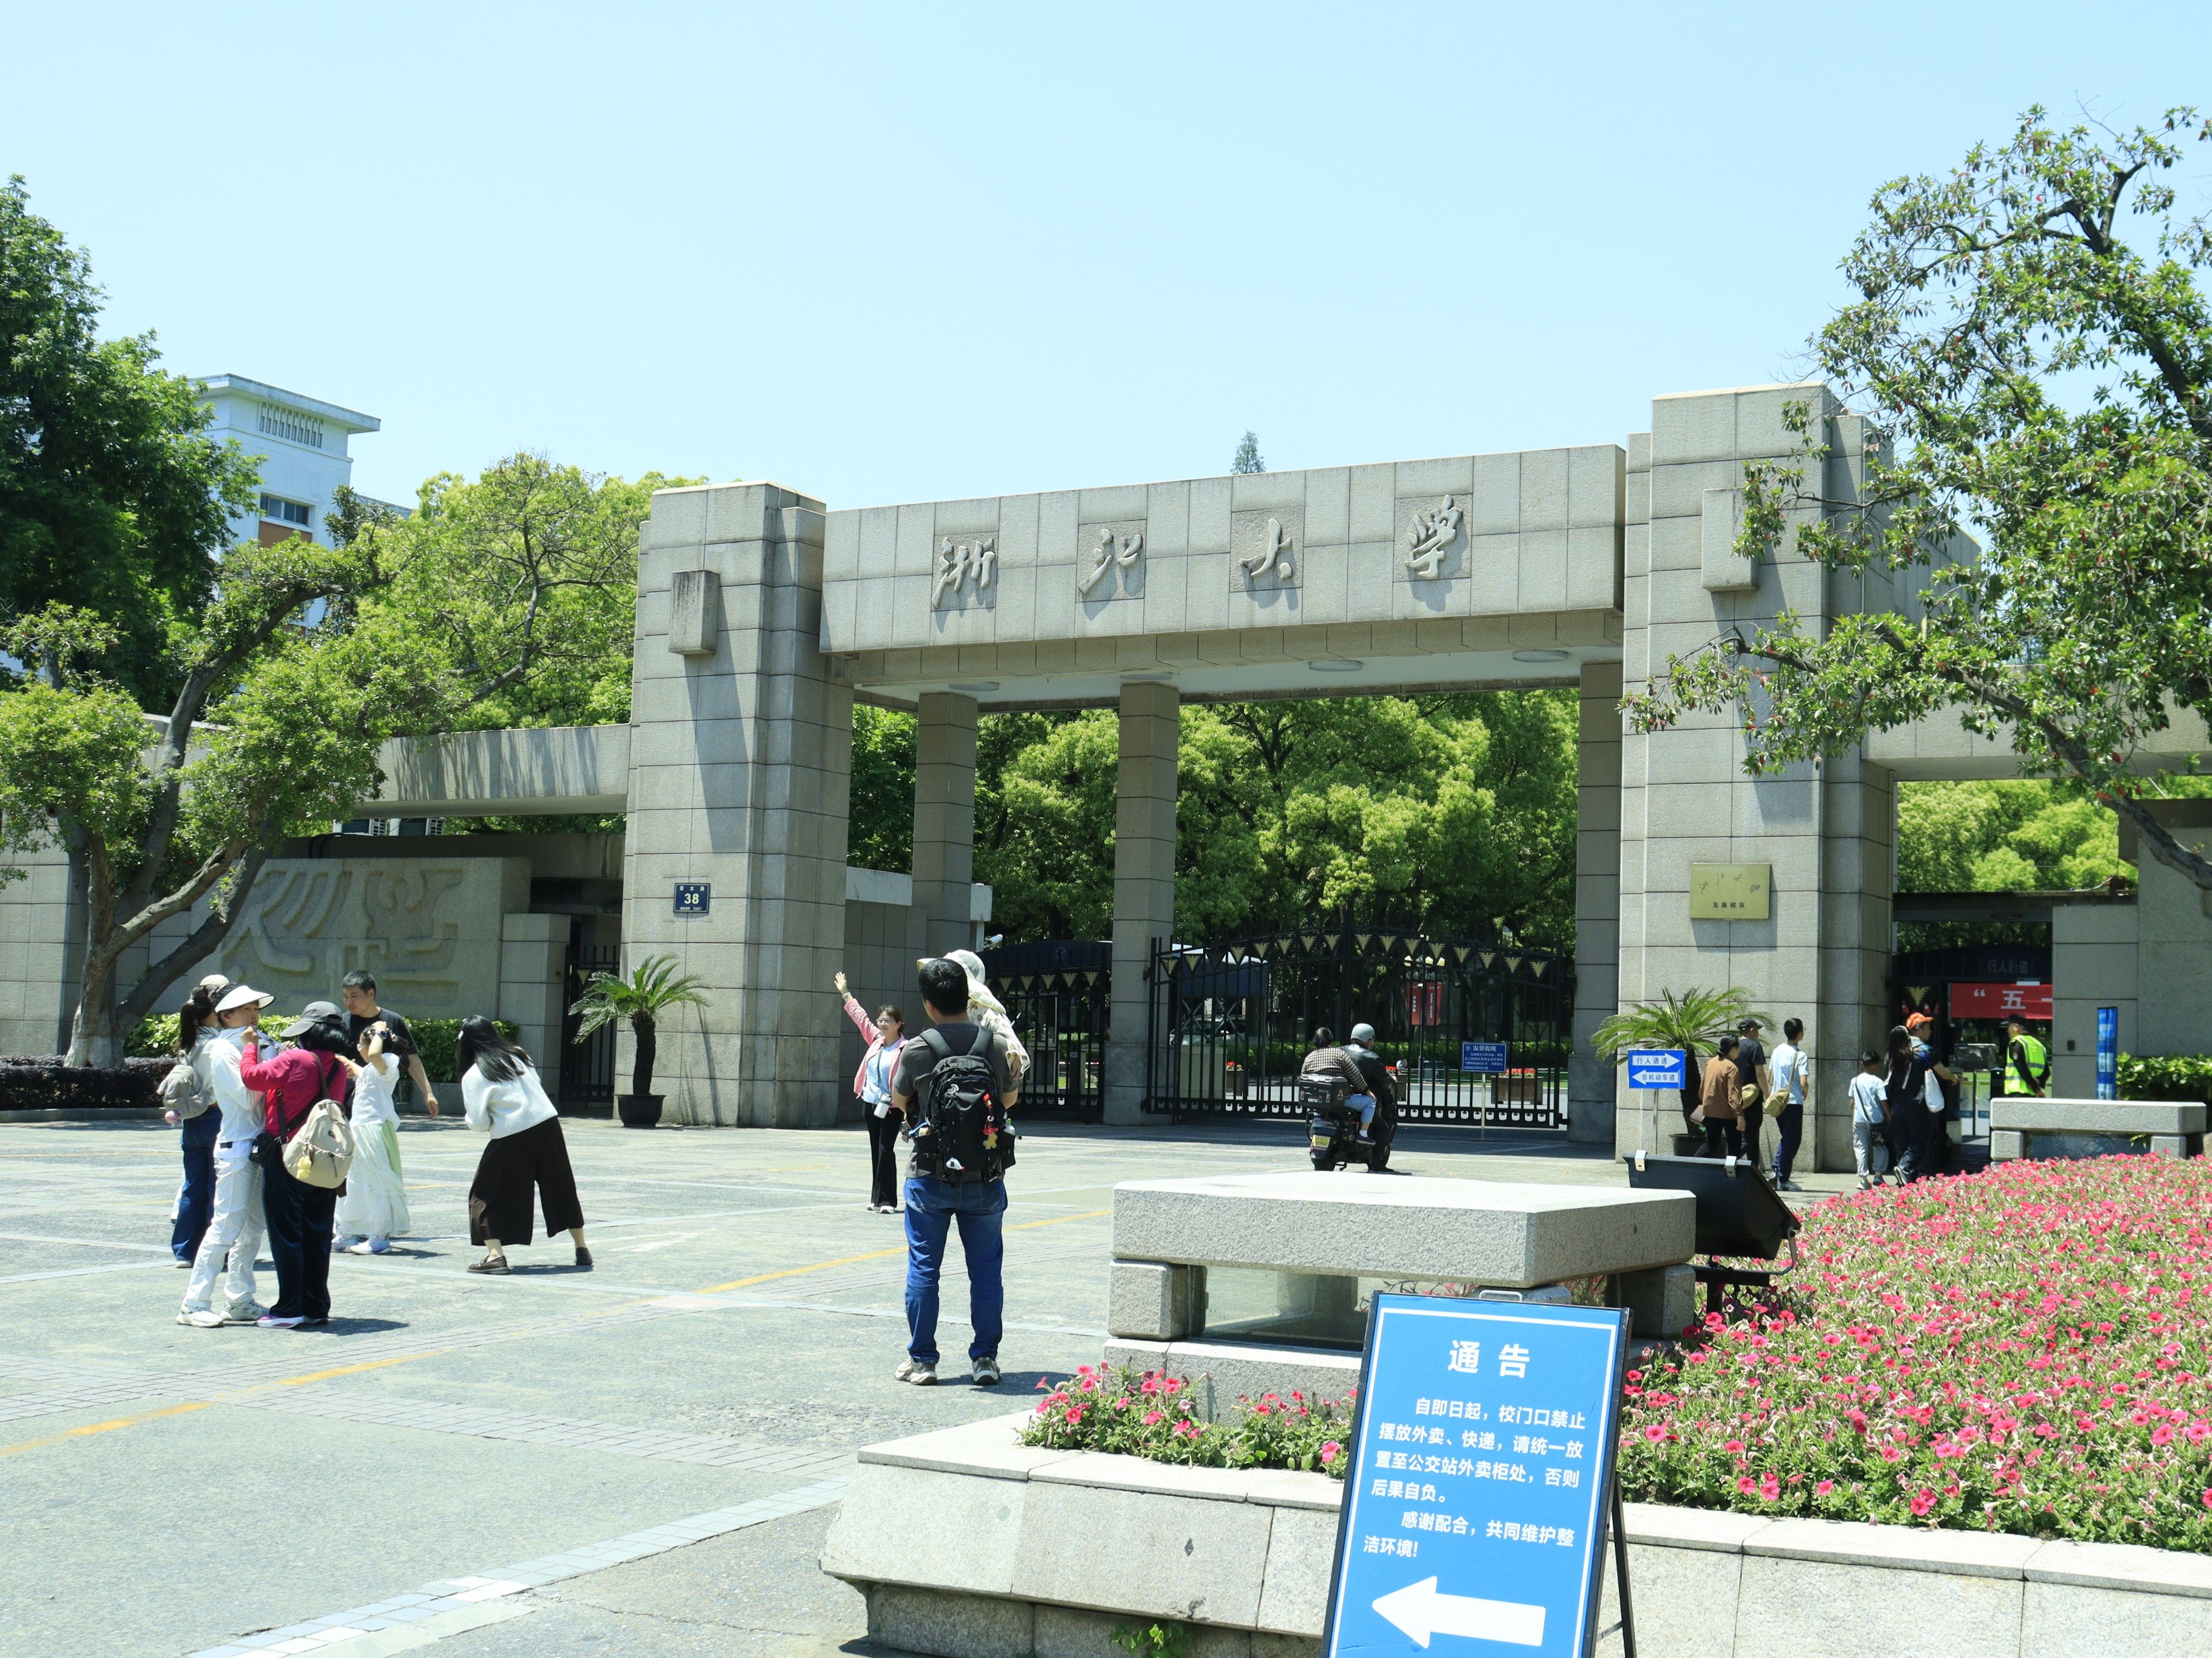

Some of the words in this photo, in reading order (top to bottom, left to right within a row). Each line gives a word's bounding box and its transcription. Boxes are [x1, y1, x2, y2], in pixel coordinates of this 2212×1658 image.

[932, 493, 1465, 609] 浙江大学
[684, 892, 699, 904] 38
[1447, 1339, 1530, 1378] 通告
[1414, 1397, 1586, 1430] 自即日起，校门口禁止
[1378, 1423, 1584, 1459] 摆放外卖、快递，请统一放
[1375, 1451, 1580, 1488] 置至公交站外卖柜处，否则
[1371, 1480, 1446, 1504] 后果自负。
[1401, 1511, 1575, 1548] 感谢配合，共同维护整
